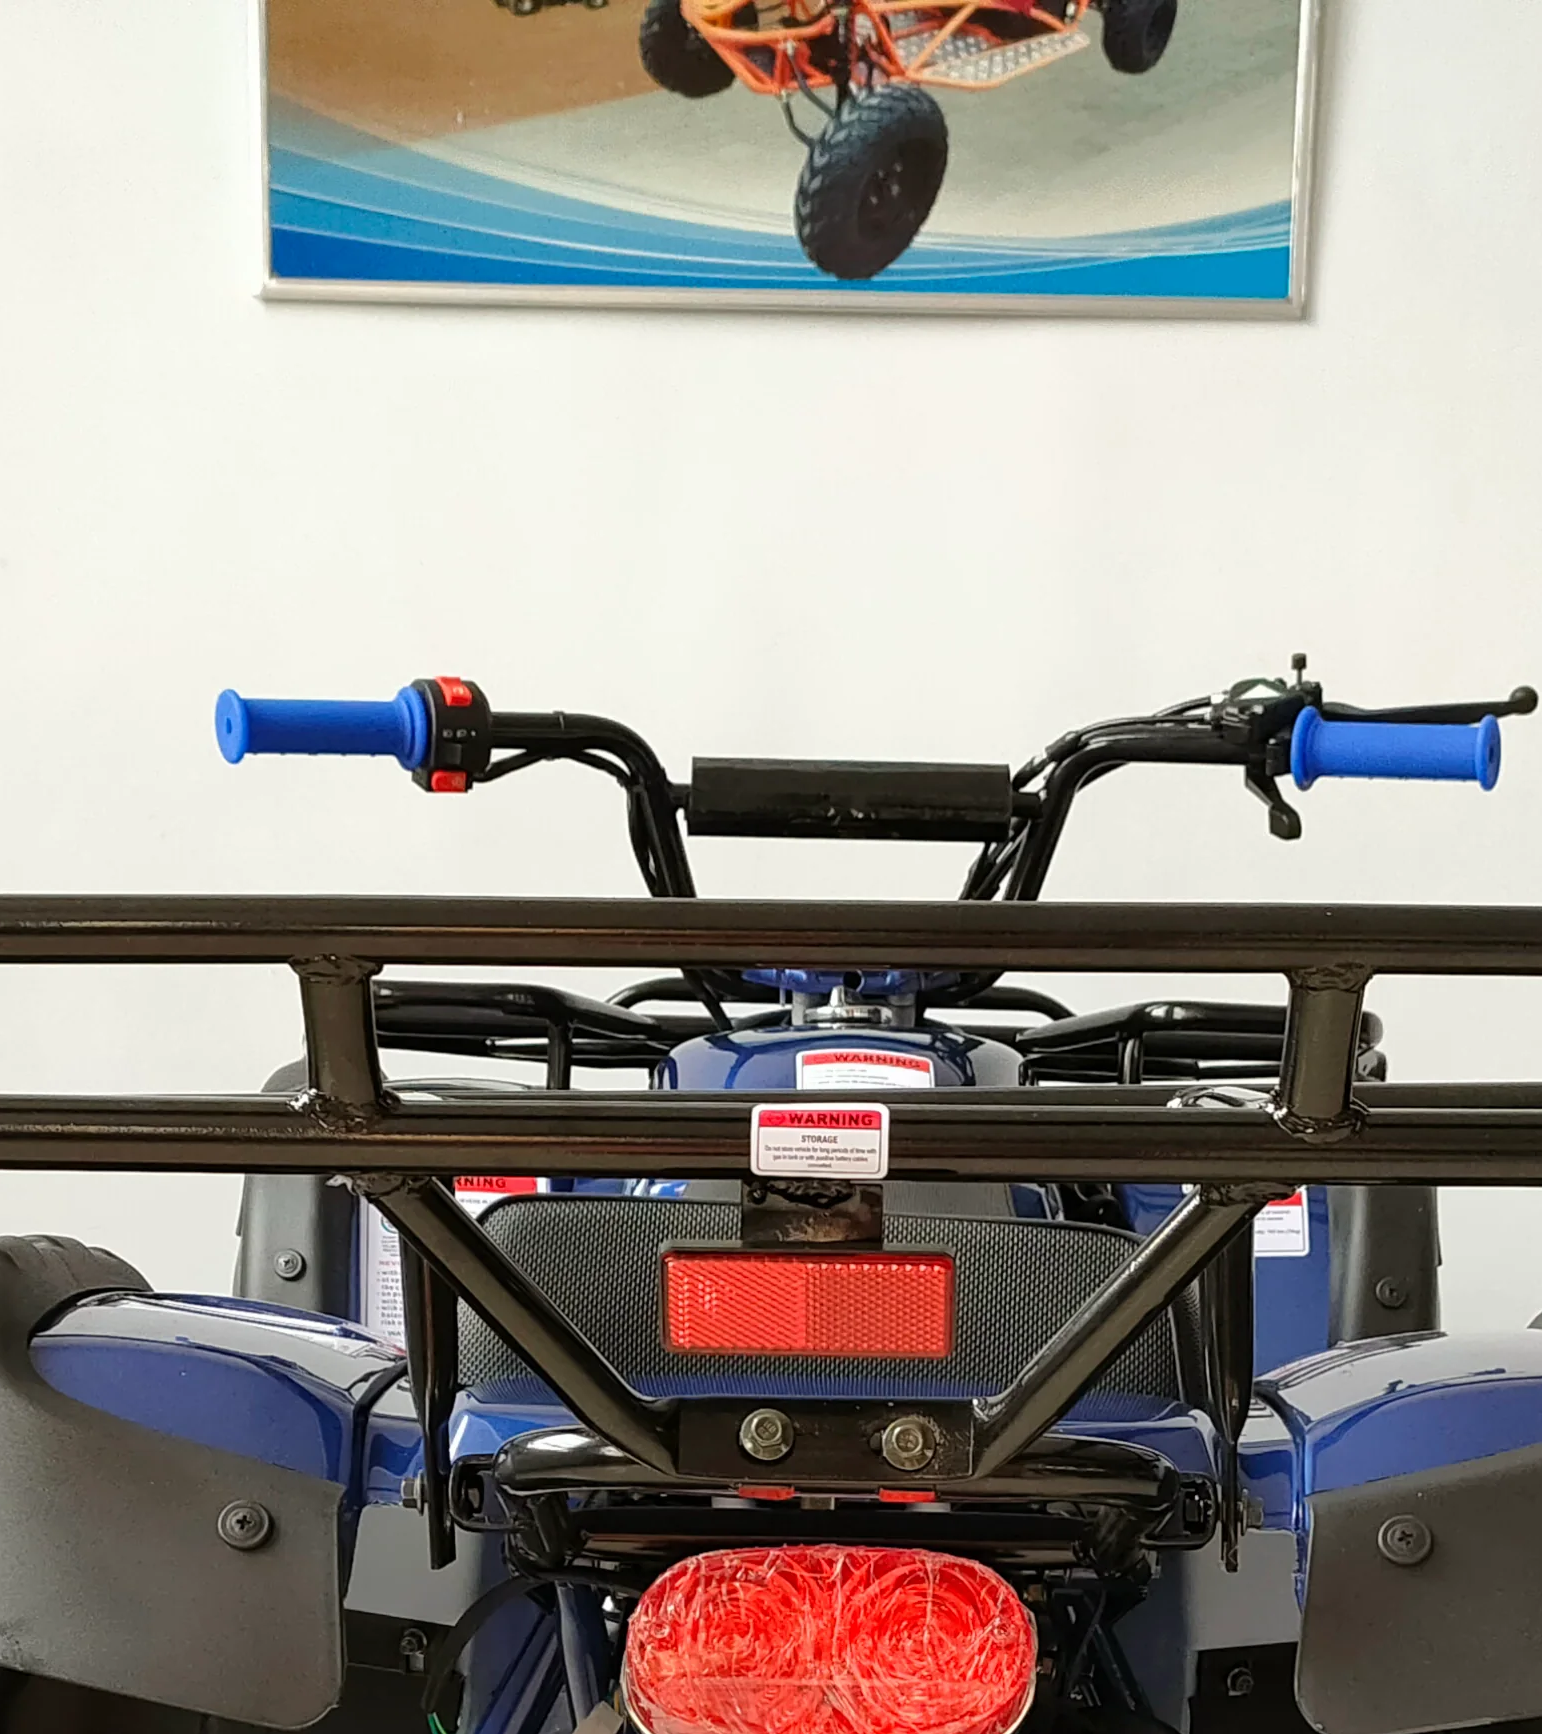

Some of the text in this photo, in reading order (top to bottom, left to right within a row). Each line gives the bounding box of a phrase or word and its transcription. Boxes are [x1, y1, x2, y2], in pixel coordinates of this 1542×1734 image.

[833, 1052, 921, 1068] WARNING
[788, 1113, 873, 1126] WARNING
[801, 1135, 838, 1144] STORAGE
